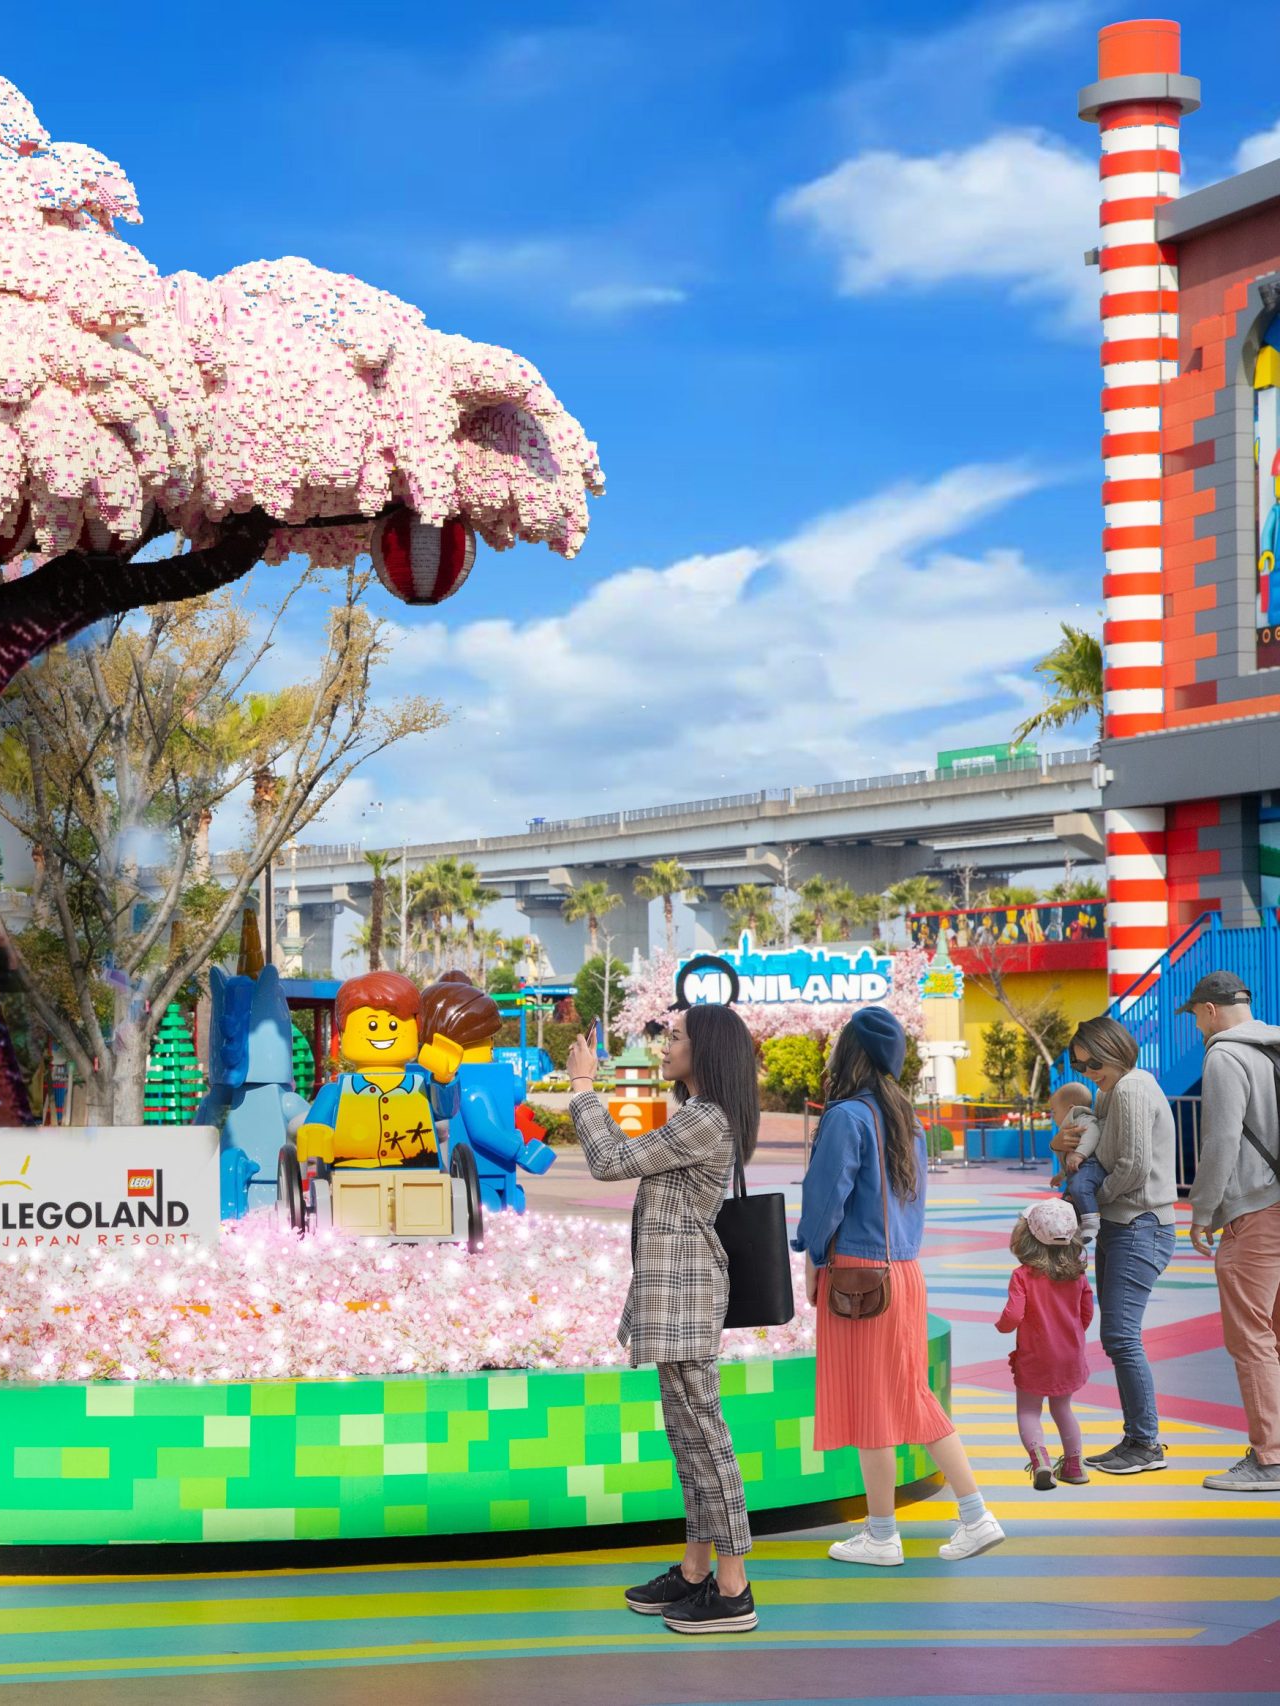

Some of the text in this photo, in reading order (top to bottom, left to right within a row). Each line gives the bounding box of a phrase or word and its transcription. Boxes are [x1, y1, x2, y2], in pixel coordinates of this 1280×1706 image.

[683, 972, 888, 1004] MINILAND
[128, 1176, 154, 1190] LEGO
[1, 1168, 190, 1230] LEGOLAND
[2, 1232, 191, 1248] JAPAN RESORT
